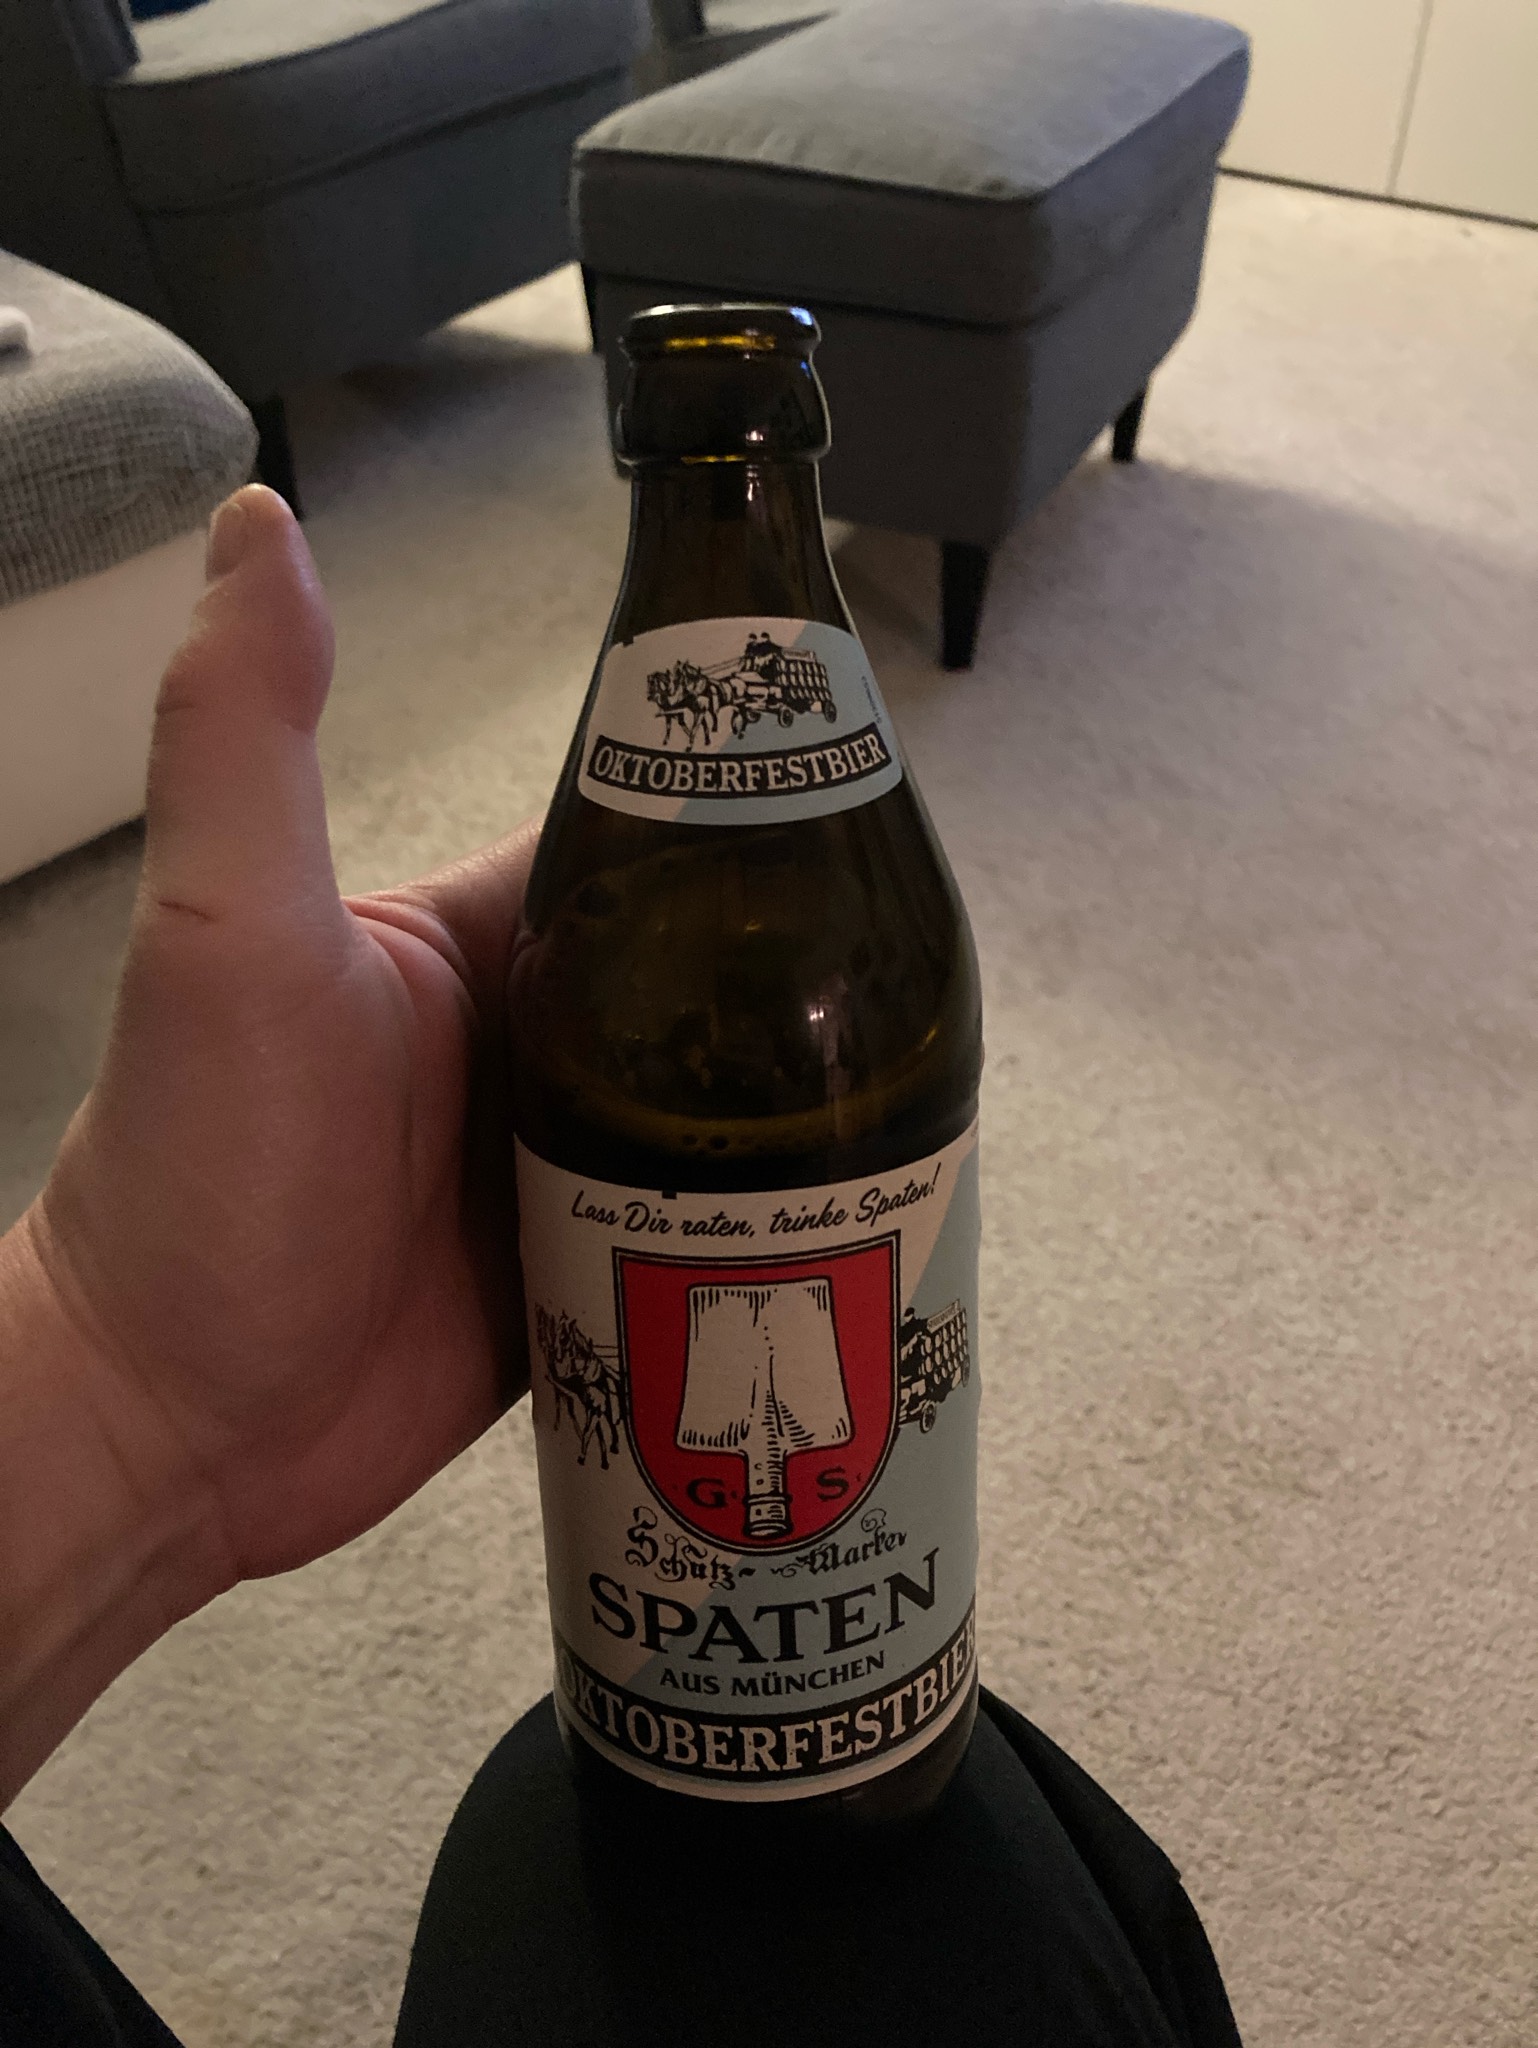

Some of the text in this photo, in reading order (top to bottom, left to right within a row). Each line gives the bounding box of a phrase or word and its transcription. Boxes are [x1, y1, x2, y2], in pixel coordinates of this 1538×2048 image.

[594, 733, 887, 792] OKTOBERFESTBIER
[571, 1162, 942, 1238] Lass Dir raten, trinke Spaten!
[588, 1548, 940, 1664] SPATEN
[659, 1650, 885, 1697] AUS MÜNCHEN
